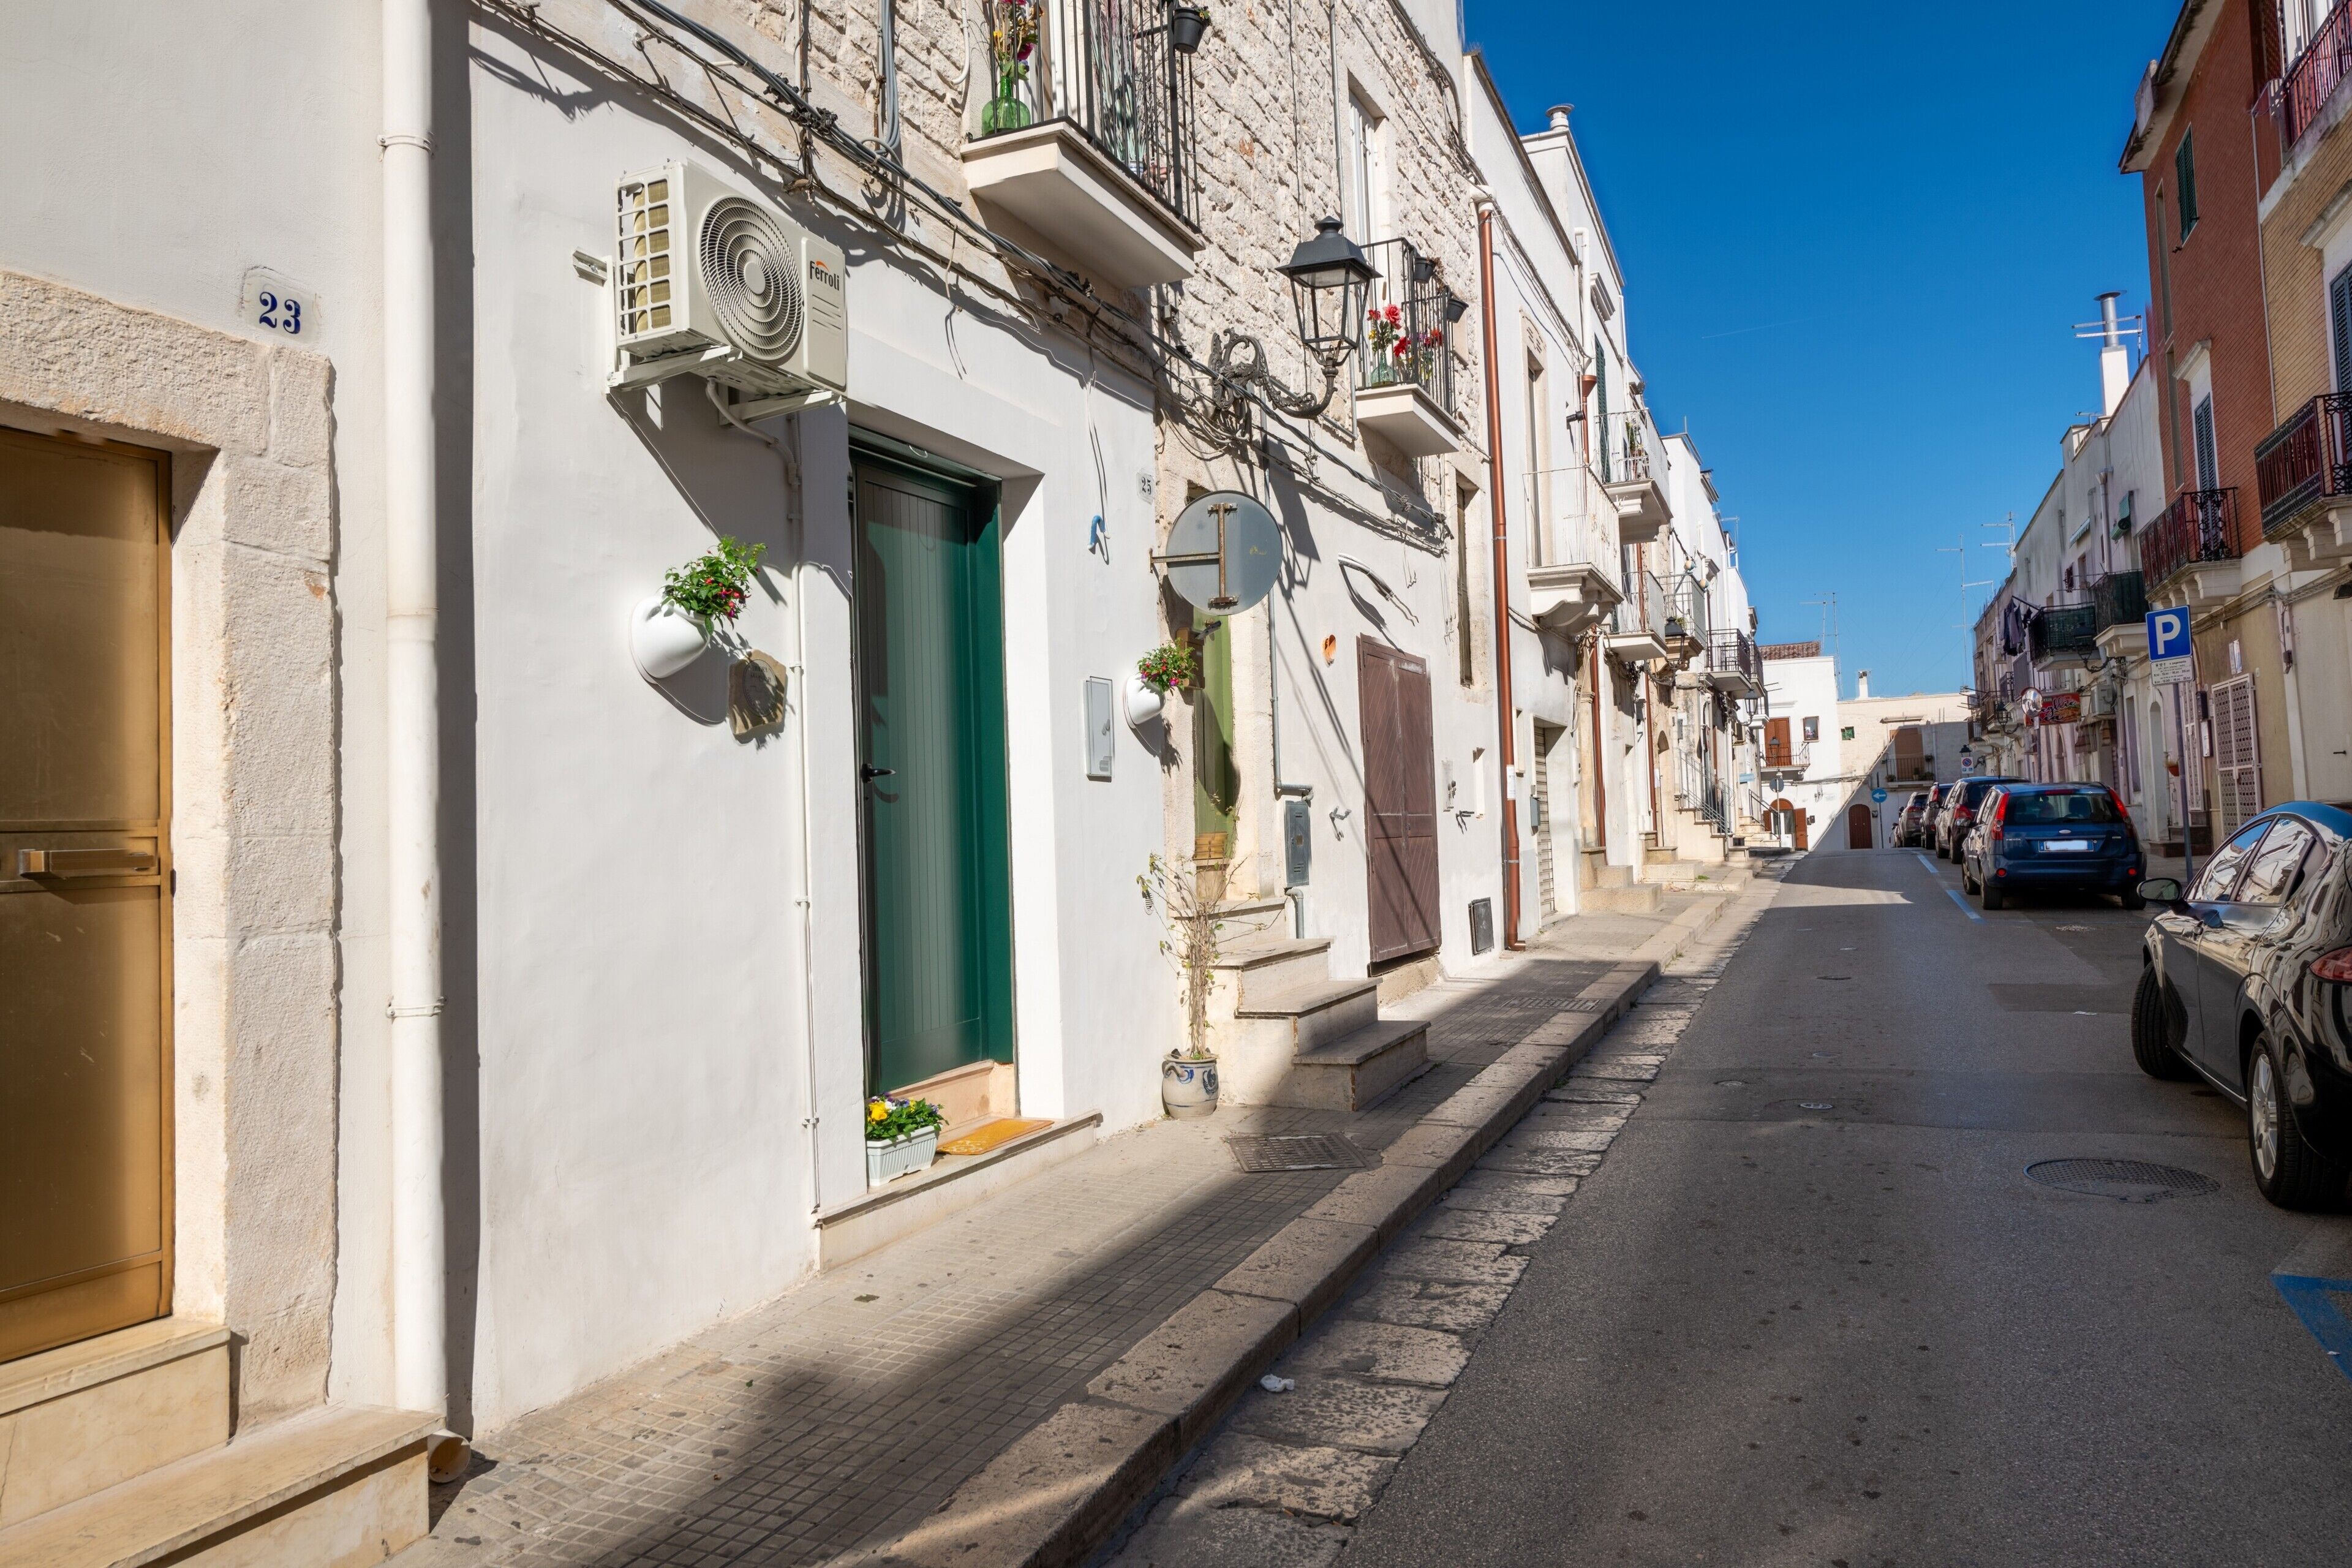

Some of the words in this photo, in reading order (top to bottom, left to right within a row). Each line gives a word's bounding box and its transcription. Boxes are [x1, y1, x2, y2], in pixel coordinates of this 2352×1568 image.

[810, 260, 840, 291] Ferroli
[259, 292, 301, 334] 23
[1141, 476, 1152, 495] 25
[2155, 614, 2180, 655] P
